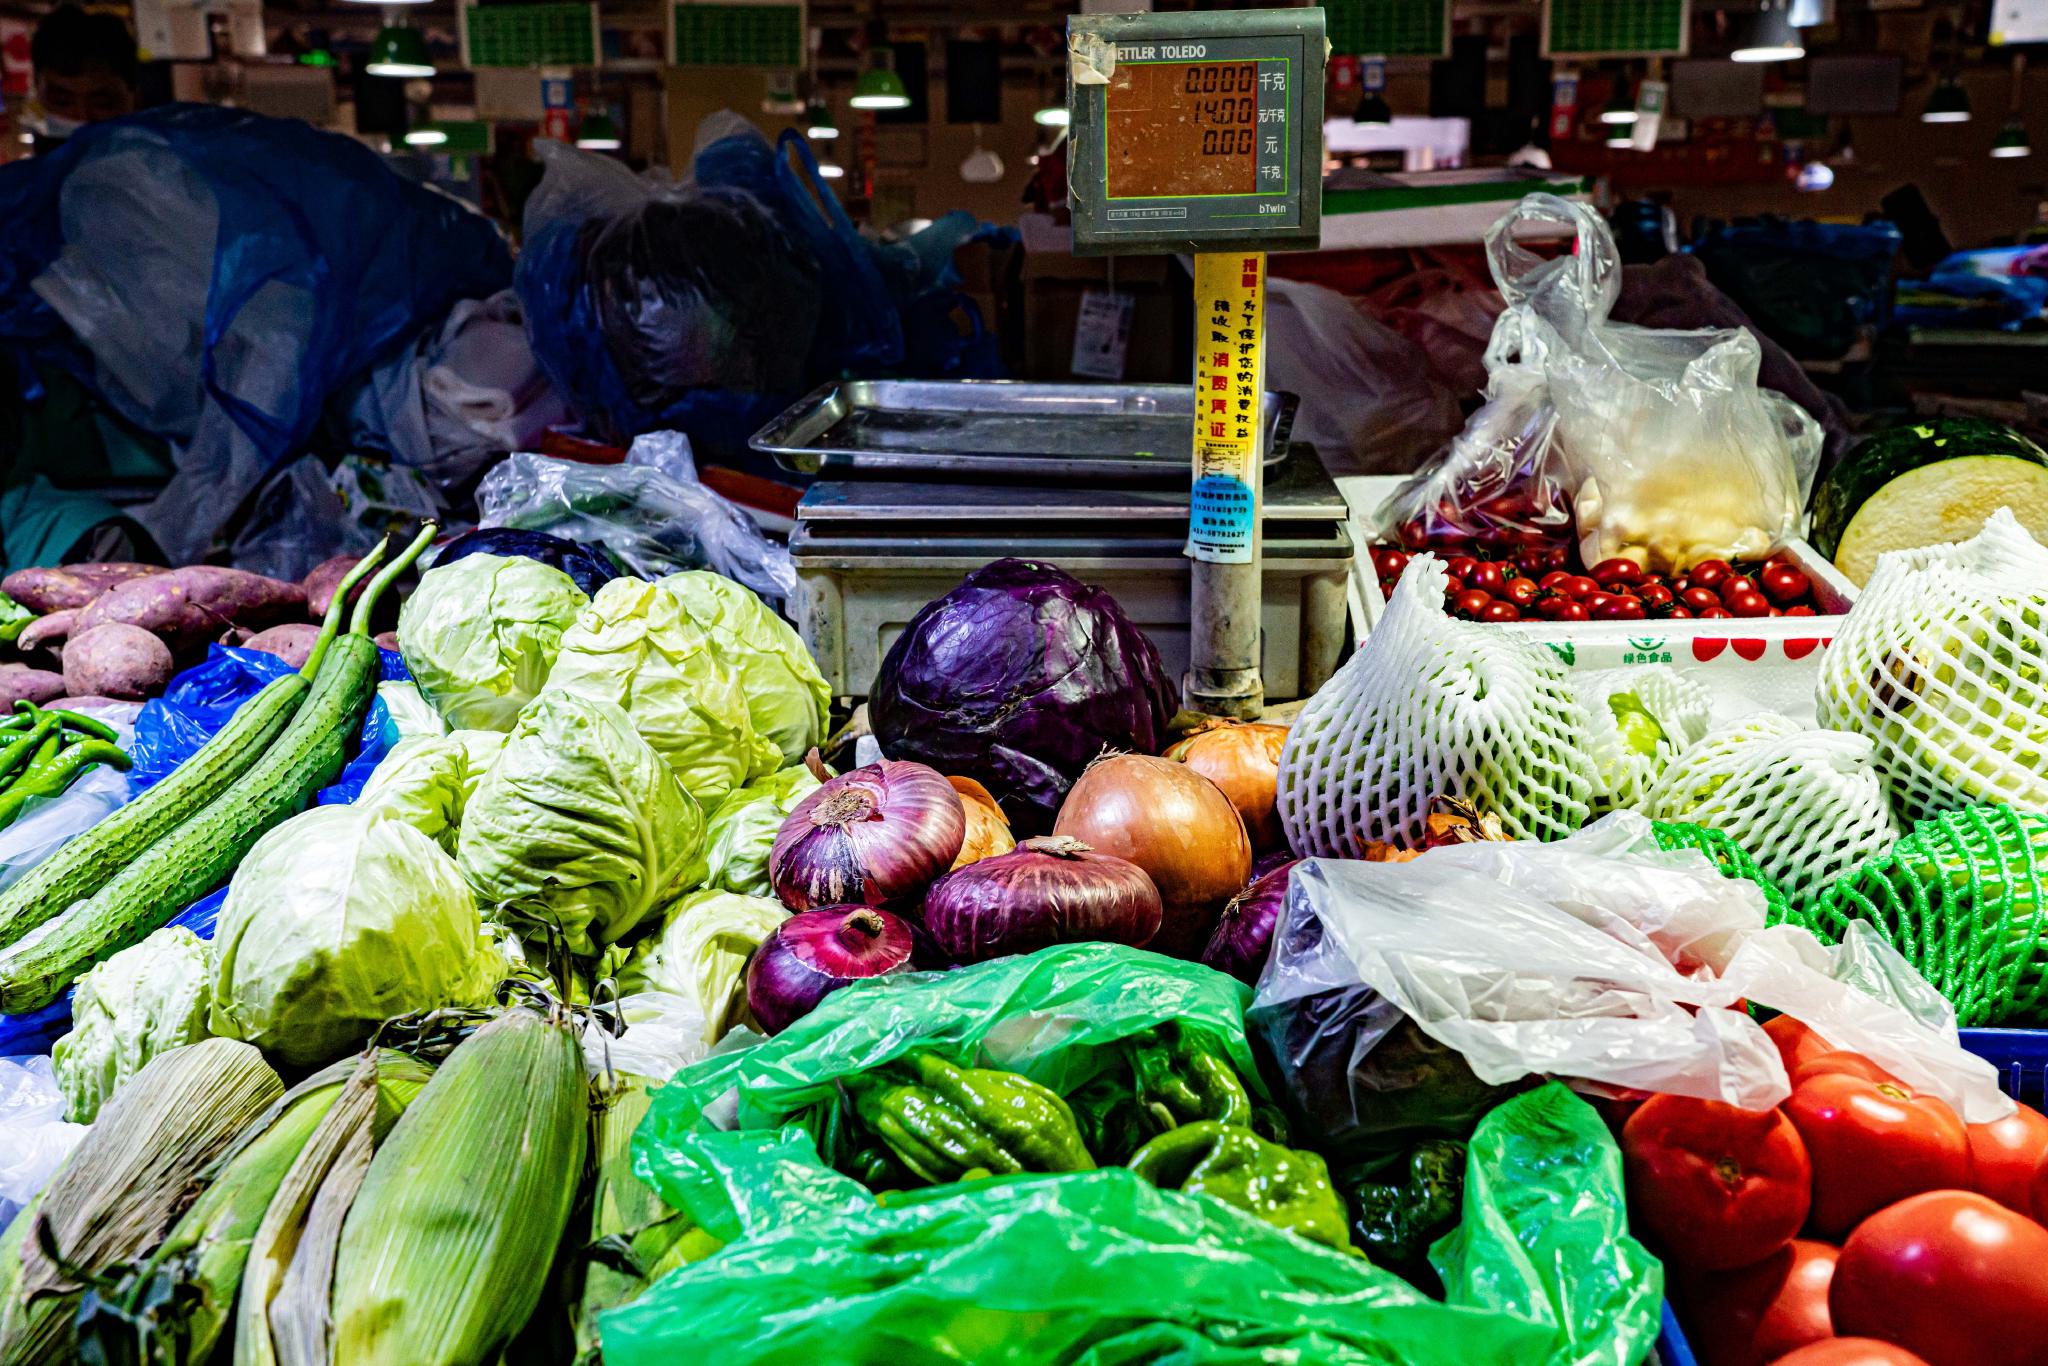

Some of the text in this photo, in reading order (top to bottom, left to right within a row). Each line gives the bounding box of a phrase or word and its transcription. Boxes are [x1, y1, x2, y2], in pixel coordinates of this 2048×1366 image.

[1160, 45, 1206, 59] TOLEDO
[1259, 72, 1286, 91] 千克
[1258, 108, 1286, 123] 元/千克
[1264, 136, 1278, 154] 元
[1260, 165, 1281, 179] 千克
[1623, 651, 1673, 665] 绿色食品
